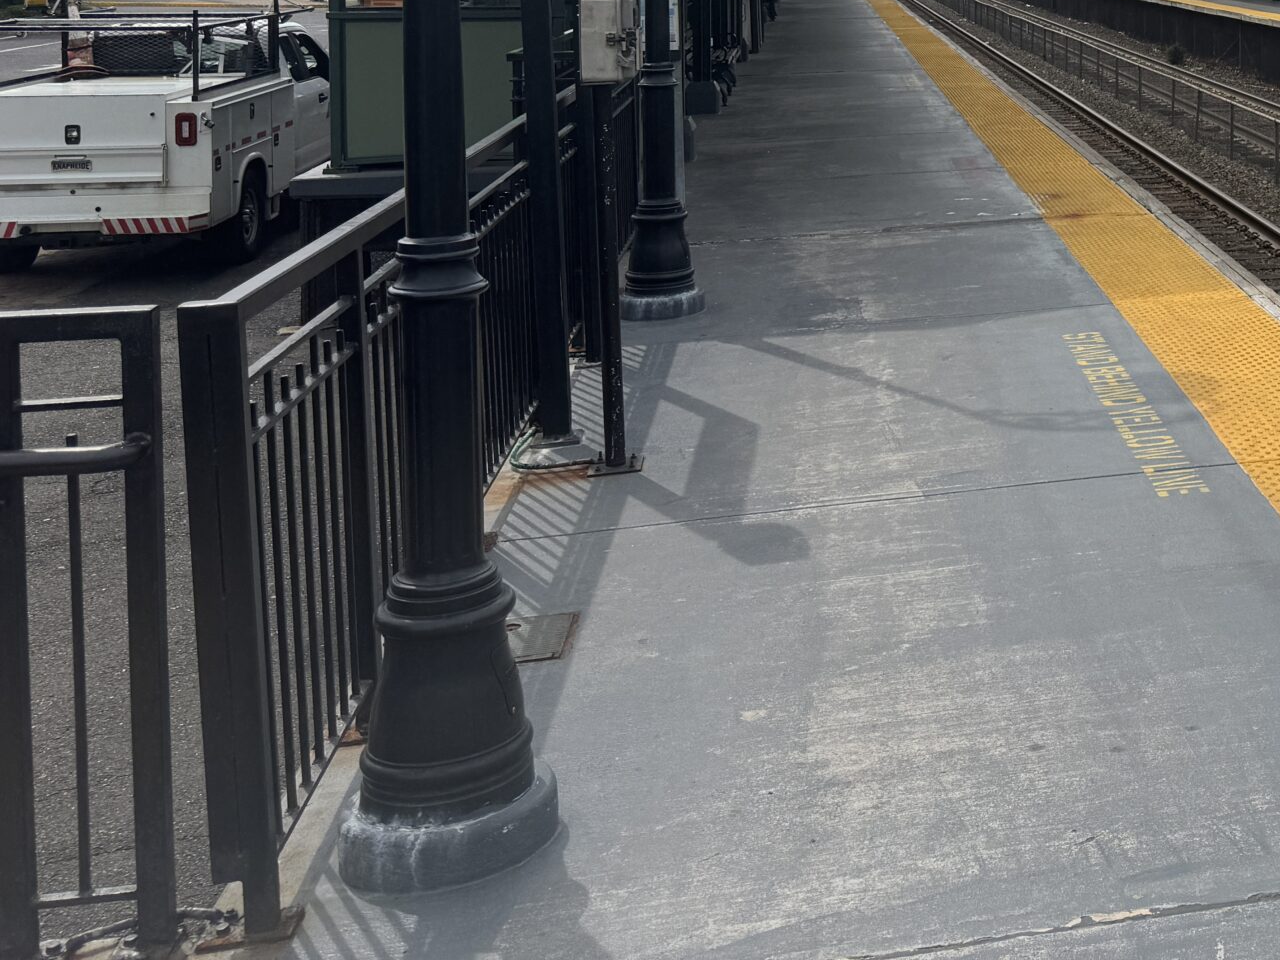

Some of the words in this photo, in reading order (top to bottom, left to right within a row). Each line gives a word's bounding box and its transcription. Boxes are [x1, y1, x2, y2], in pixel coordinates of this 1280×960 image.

[1062, 332, 1119, 365] STAND
[1082, 366, 1147, 407] BEHIND
[1108, 406, 1187, 460] YELLOW
[1140, 461, 1211, 497] LINE
